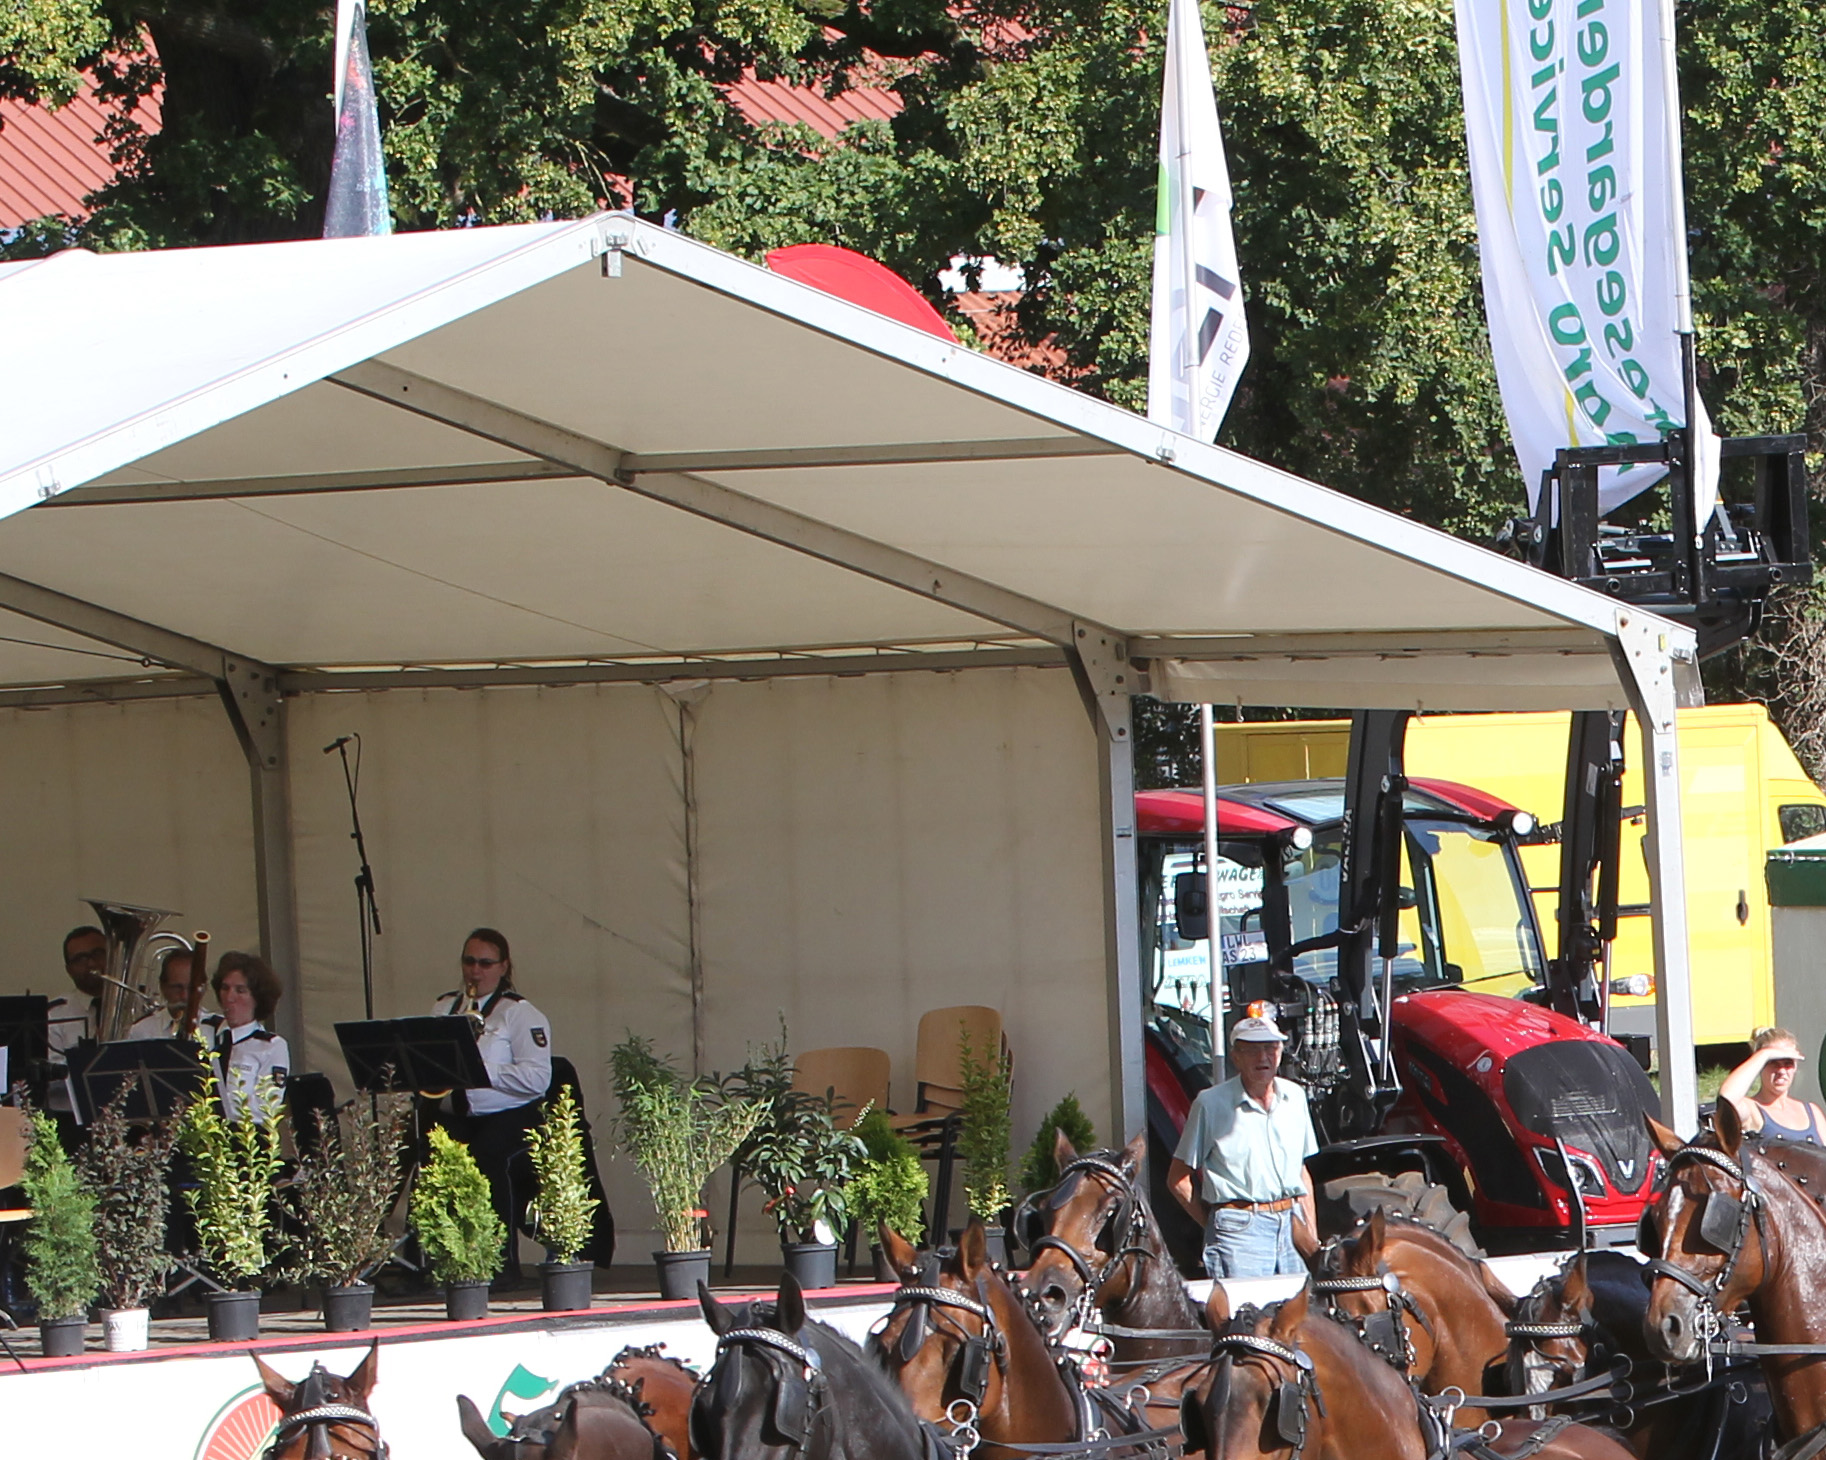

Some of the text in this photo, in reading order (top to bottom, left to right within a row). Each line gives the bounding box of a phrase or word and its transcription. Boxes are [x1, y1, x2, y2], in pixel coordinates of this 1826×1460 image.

[1226, 934, 1253, 949] LWL
[1167, 955, 1207, 968] LEMKEN
[1221, 947, 1257, 963] AS 23
